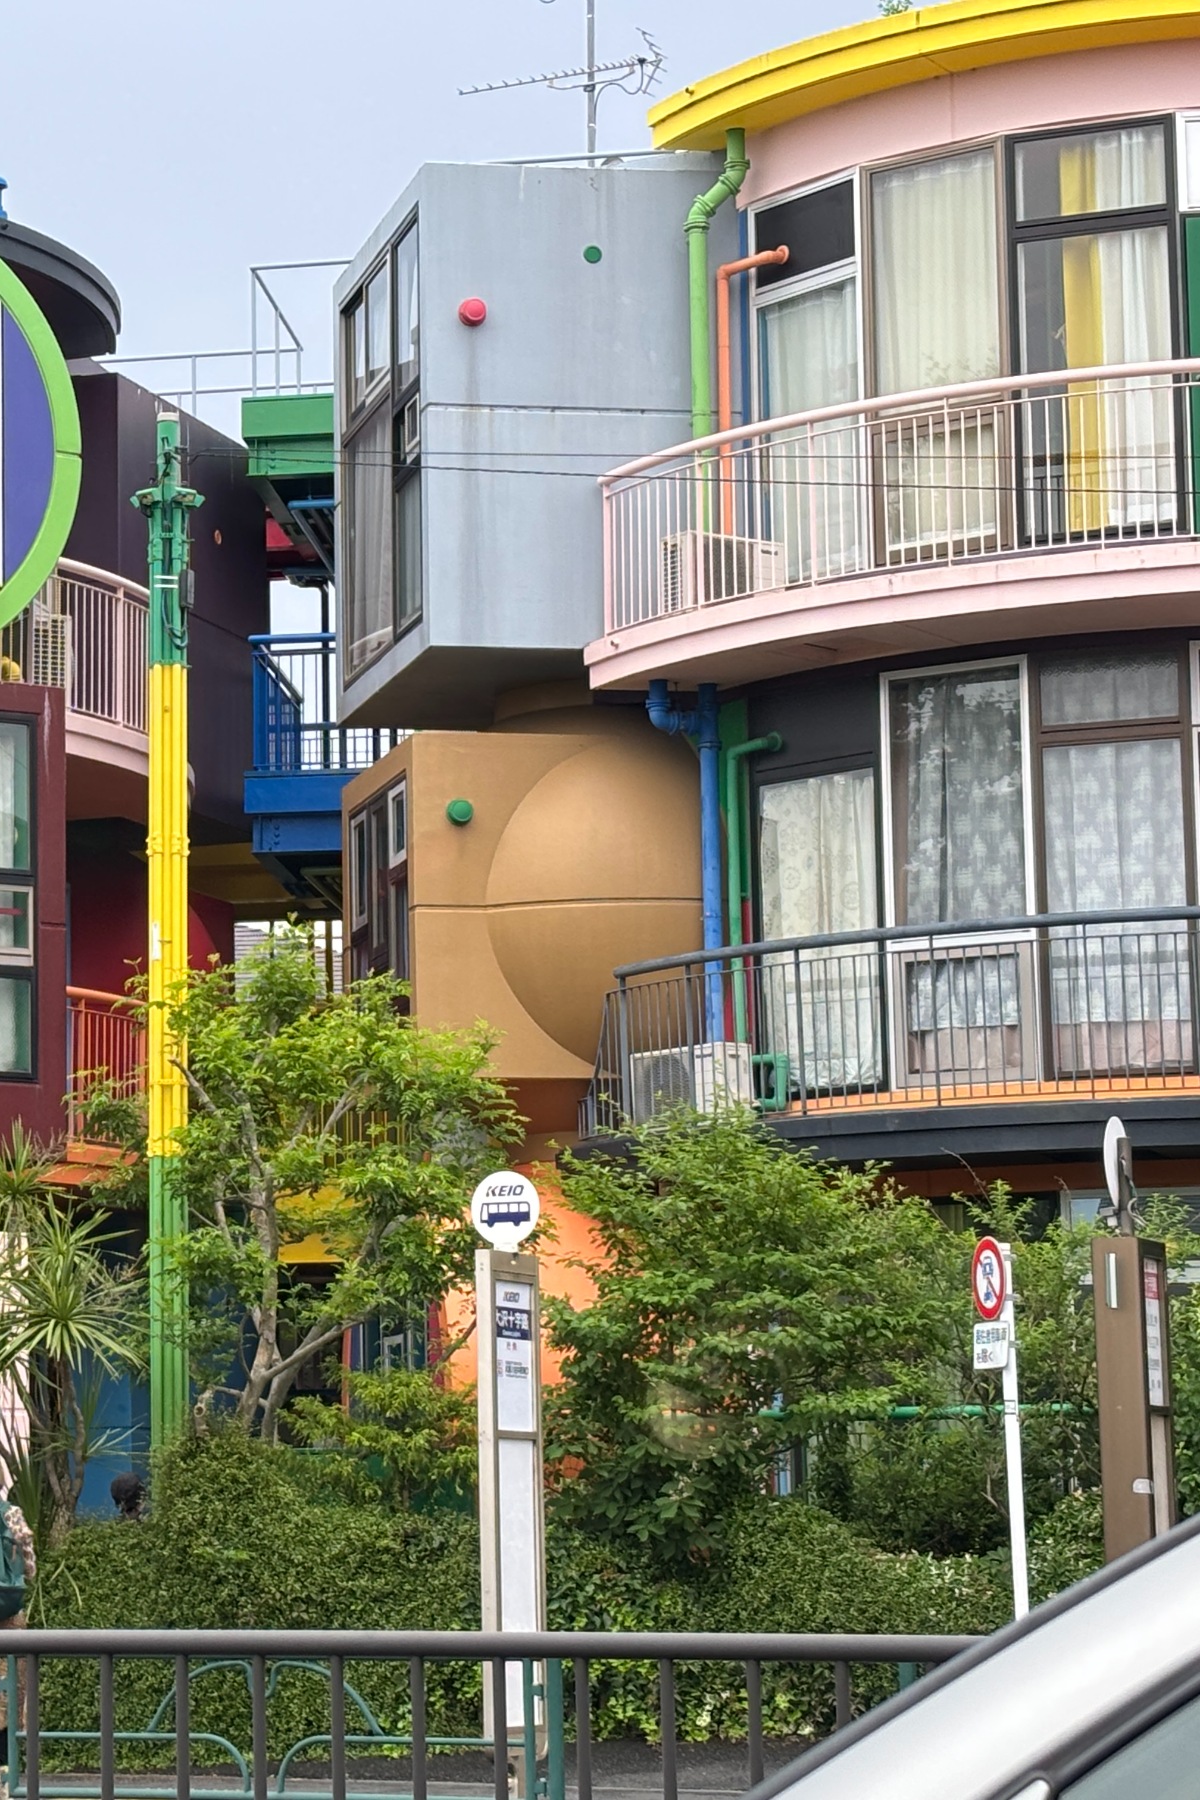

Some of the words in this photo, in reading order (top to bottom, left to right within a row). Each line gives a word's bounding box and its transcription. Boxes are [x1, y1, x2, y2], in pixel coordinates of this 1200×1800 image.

[486, 1184, 525, 1197] KEIO
[976, 1348, 993, 1363] を除く
